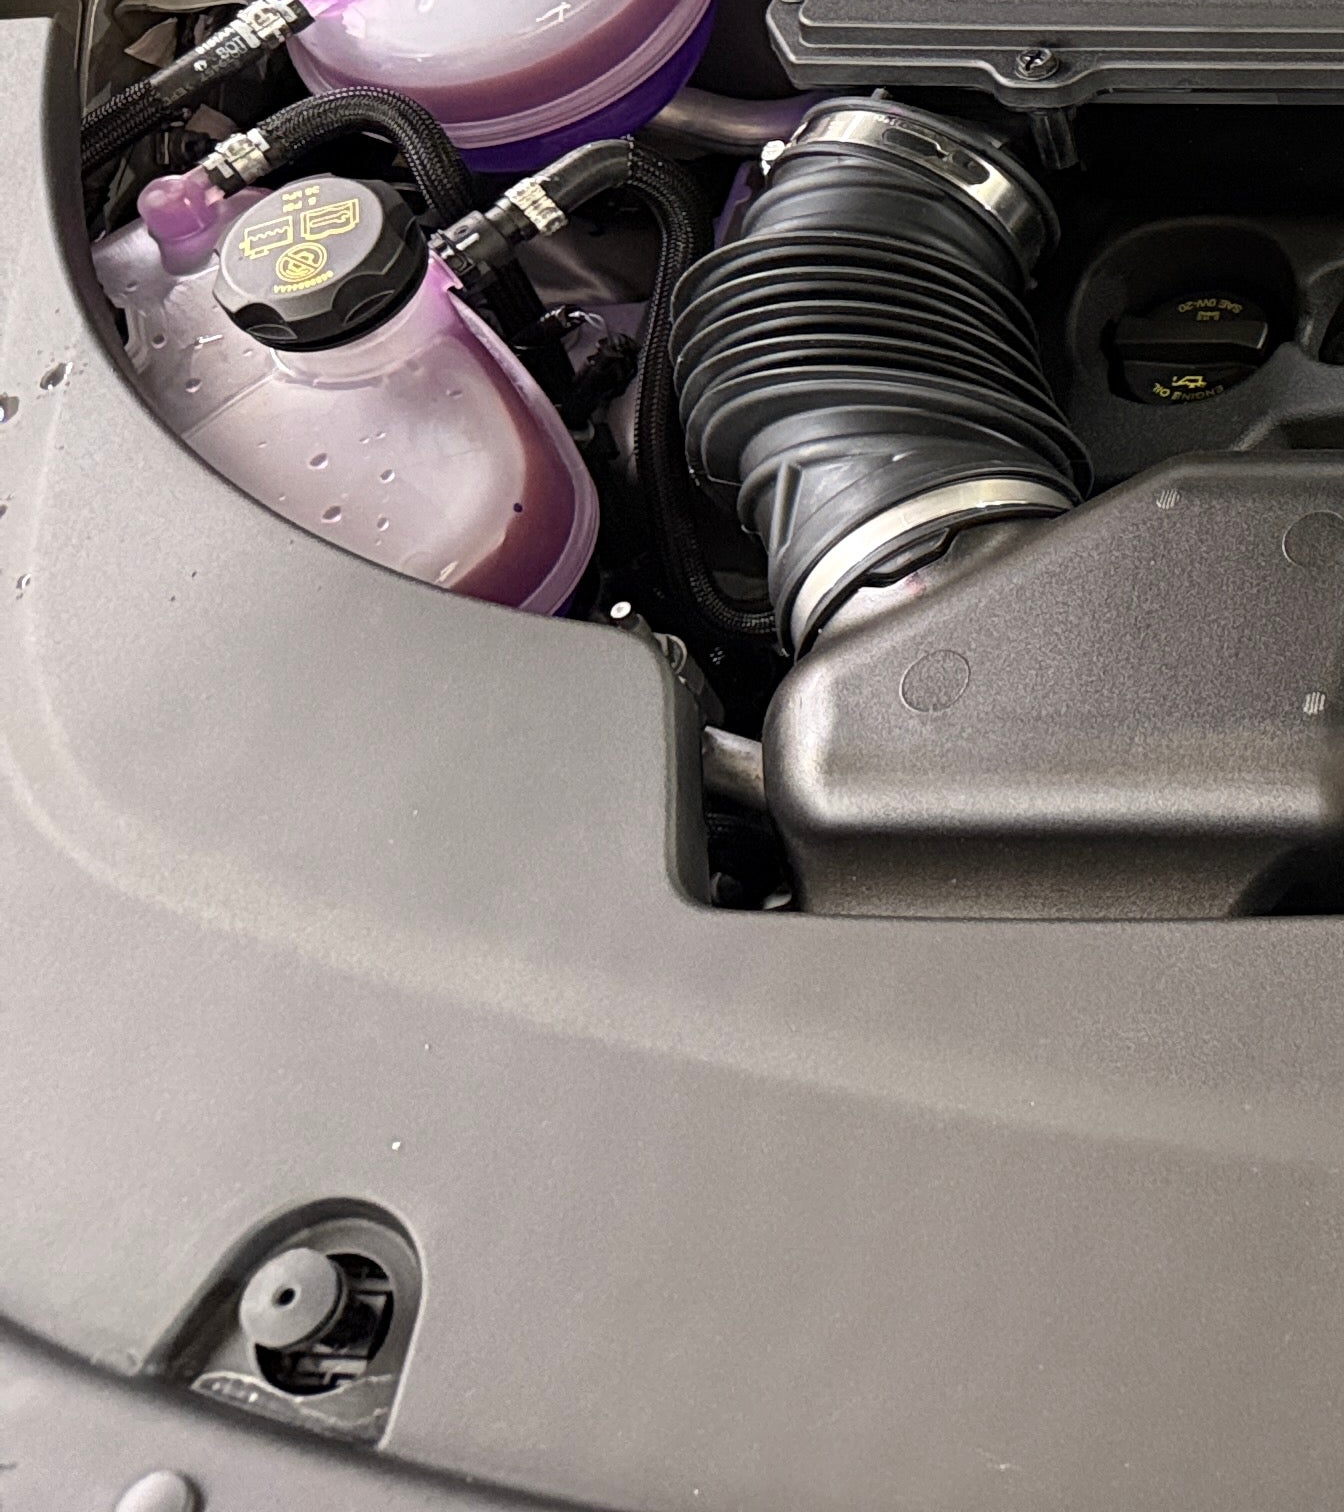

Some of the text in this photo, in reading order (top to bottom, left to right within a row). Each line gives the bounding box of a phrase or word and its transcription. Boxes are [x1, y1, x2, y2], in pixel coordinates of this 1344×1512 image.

[1178, 298, 1242, 314] SAE 0W-20
[1152, 382, 1224, 401] ENGINE OIL
